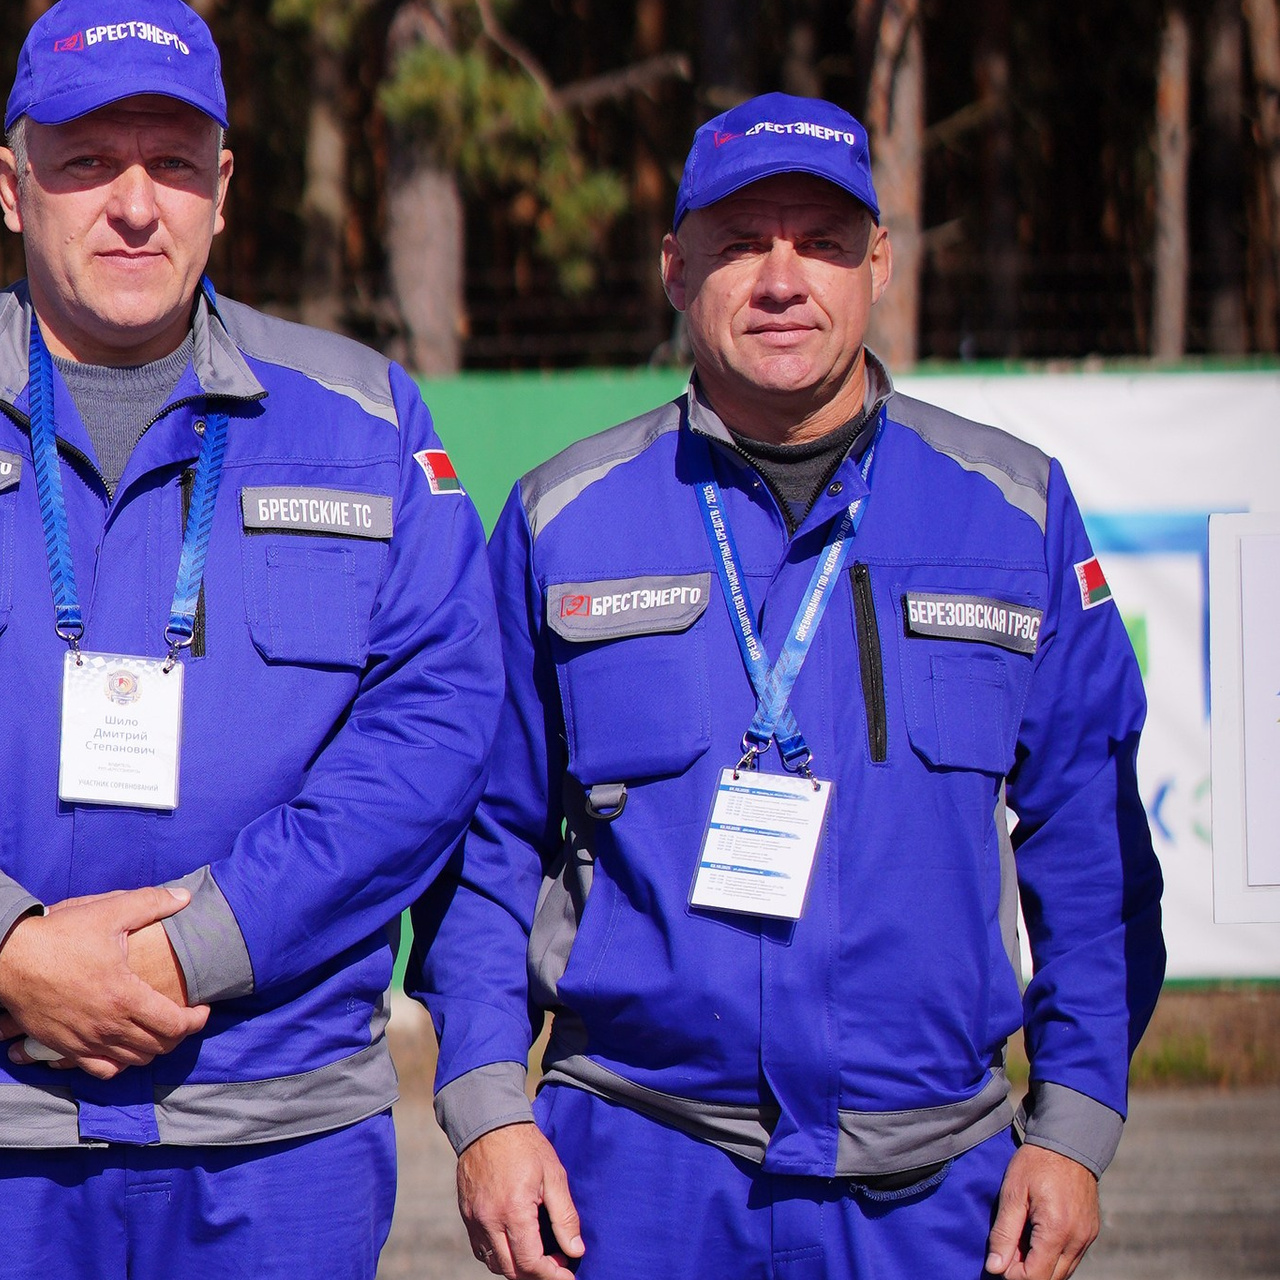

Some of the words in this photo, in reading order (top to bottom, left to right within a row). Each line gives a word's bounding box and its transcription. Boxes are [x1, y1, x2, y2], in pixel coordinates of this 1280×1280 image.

[86, 21, 189, 55] БРЕСТЭНЕРГО
[701, 484, 716, 504] 2025
[258, 498, 350, 526] БРЕСТСКИЕ
[353, 503, 372, 528] ТС
[709, 509, 727, 541] СРЕДСТВ
[718, 540, 741, 594] ТРАНСПОРТНЫХ
[592, 587, 701, 615] БРЕСТЭНЕРГО
[731, 593, 752, 635] ВОДИТЕЛЕЙ
[795, 588, 822, 641] СОРЕВНОВАНИЯ
[815, 574, 828, 590] ГПО
[908, 600, 1006, 633] БЕРЕЗОВСКАЯ
[1007, 612, 1040, 641] ГРЭС
[744, 634, 761, 660] СРЕДИ
[94, 728, 148, 741] Дмитрий
[105, 715, 138, 726] Шило
[85, 741, 155, 755] Степанович
